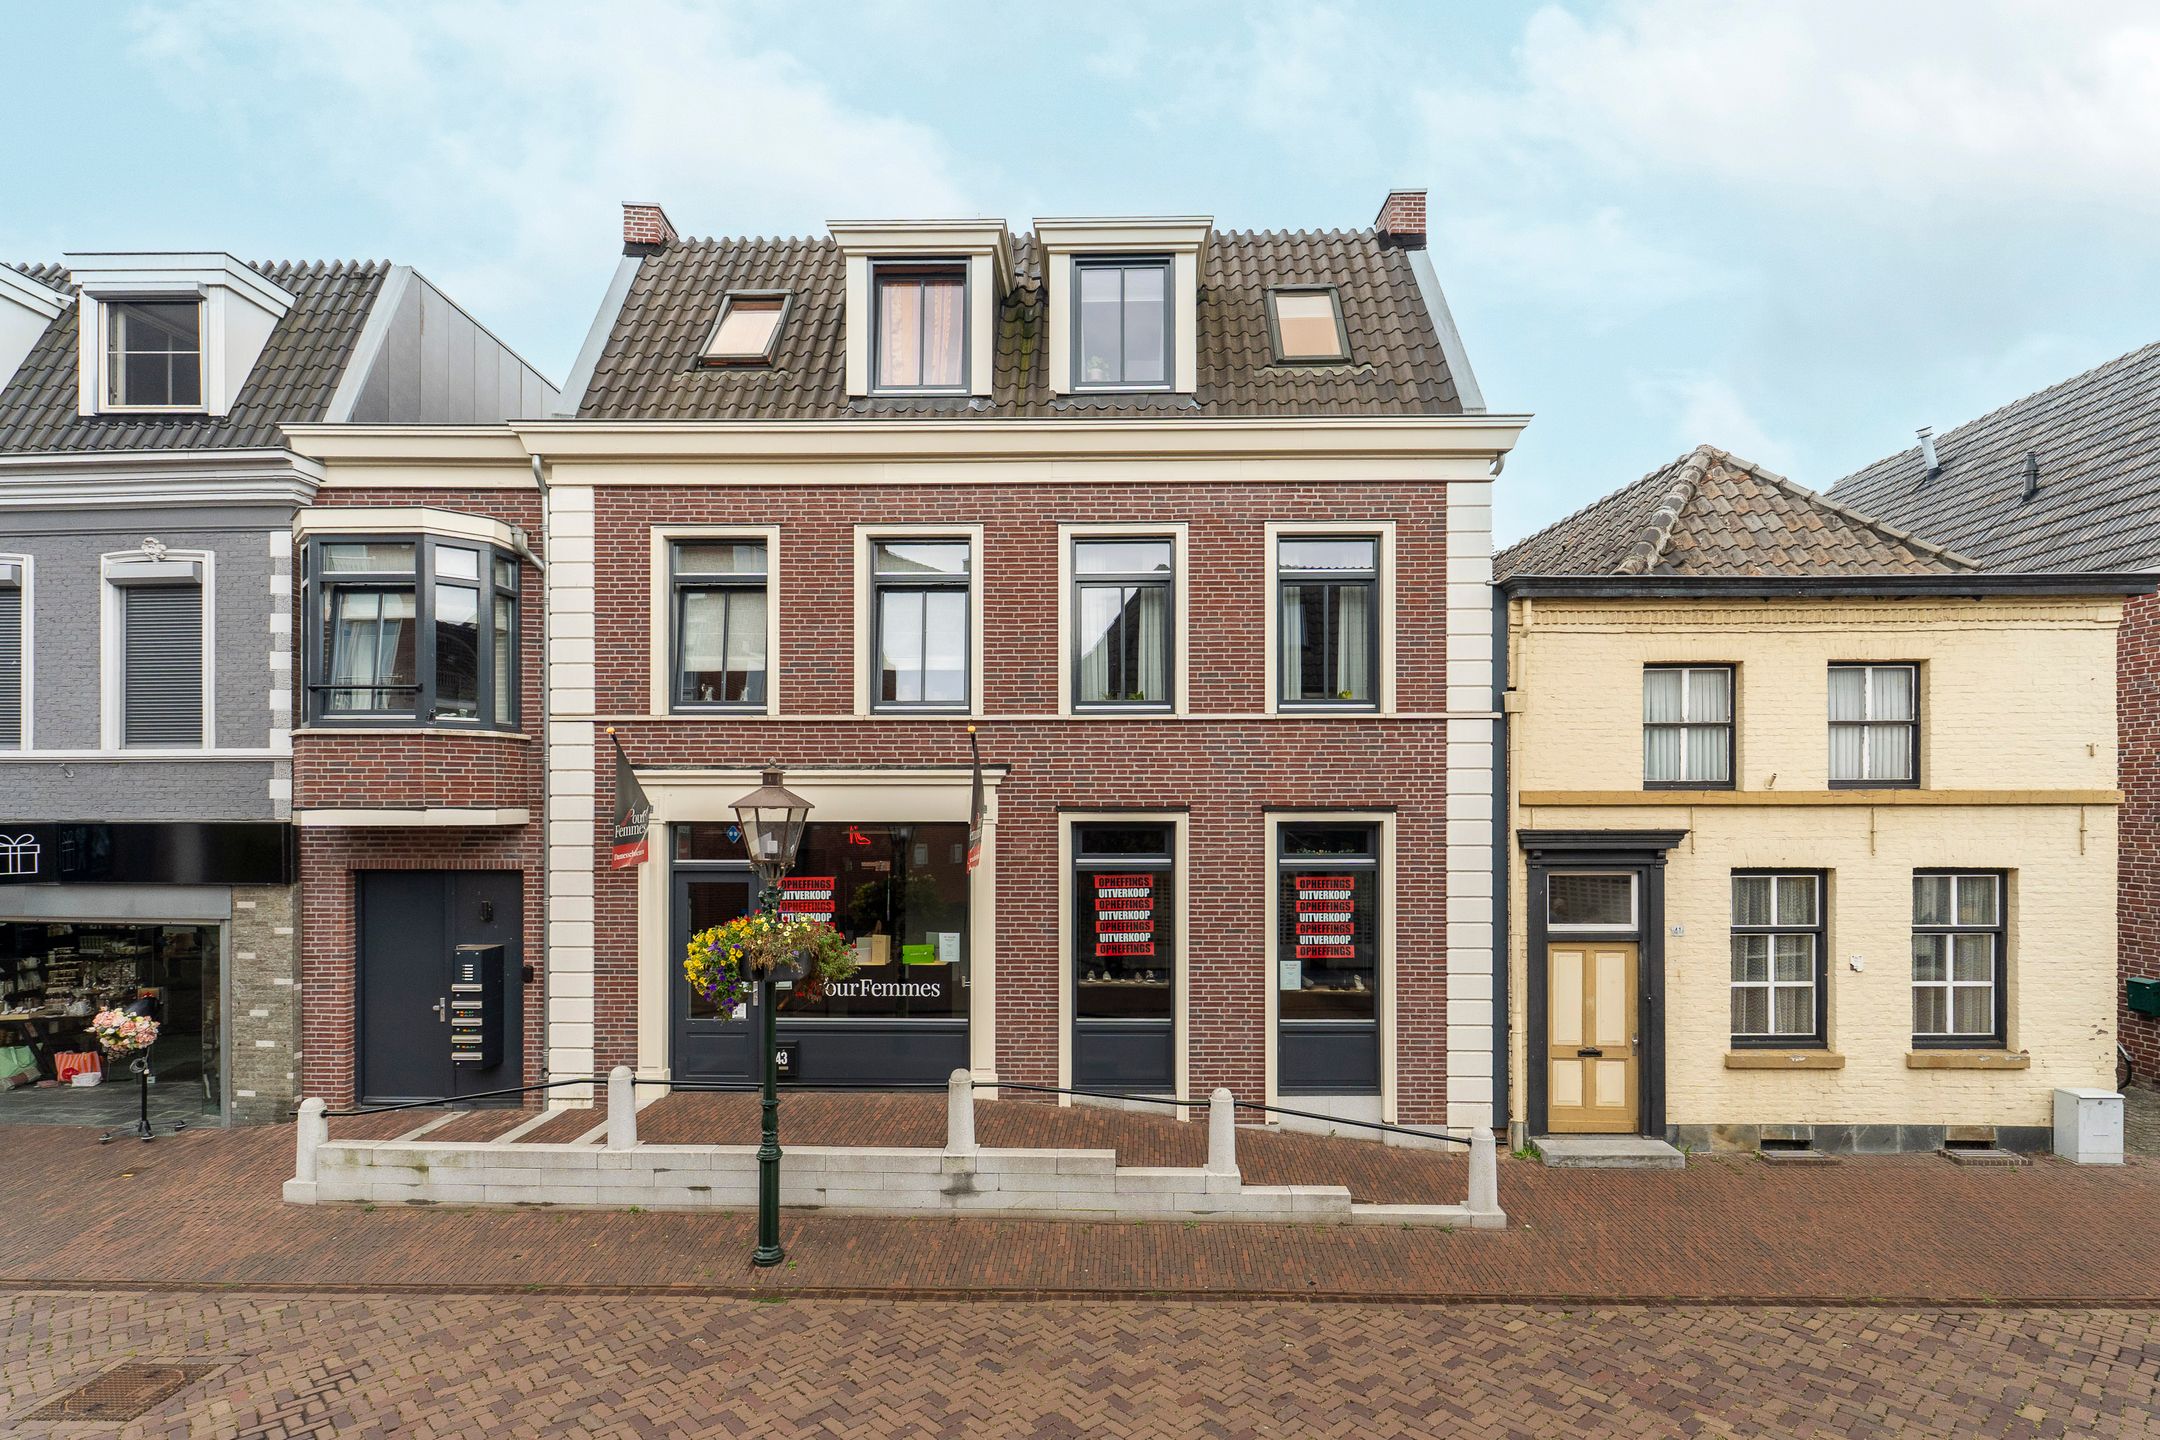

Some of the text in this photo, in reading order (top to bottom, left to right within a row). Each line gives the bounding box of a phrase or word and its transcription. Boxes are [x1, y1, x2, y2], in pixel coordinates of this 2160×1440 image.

[615, 824, 646, 838] Femmes
[781, 879, 832, 889] OPHEFFINGS
[1098, 877, 1150, 887] OPHEFFINGS
[1299, 879, 1351, 889] OPHEFFINGS
[1098, 888, 1150, 898] UITVERKOOP
[1299, 890, 1351, 900] UITVERKOOP
[781, 901, 832, 911] OPHEFFINGS
[1099, 899, 1150, 909] OPHEFFINGS
[1299, 901, 1351, 911] OPHEFFINGS
[1099, 910, 1151, 920] UITVERKOOP
[1299, 912, 1351, 923] UITVERKOOP
[1099, 921, 1151, 931] OPHEFFINGS
[1299, 923, 1351, 933] OPHEFFINGS
[1099, 932, 1151, 943] UITVERKOOP
[1299, 935, 1351, 945] UITVERKOOP
[1100, 943, 1151, 954] OPHEFFINGS
[1299, 946, 1351, 956] OPHEFFINGS
[823, 978, 941, 997] ourFemmes
[776, 1051, 788, 1065] 43
